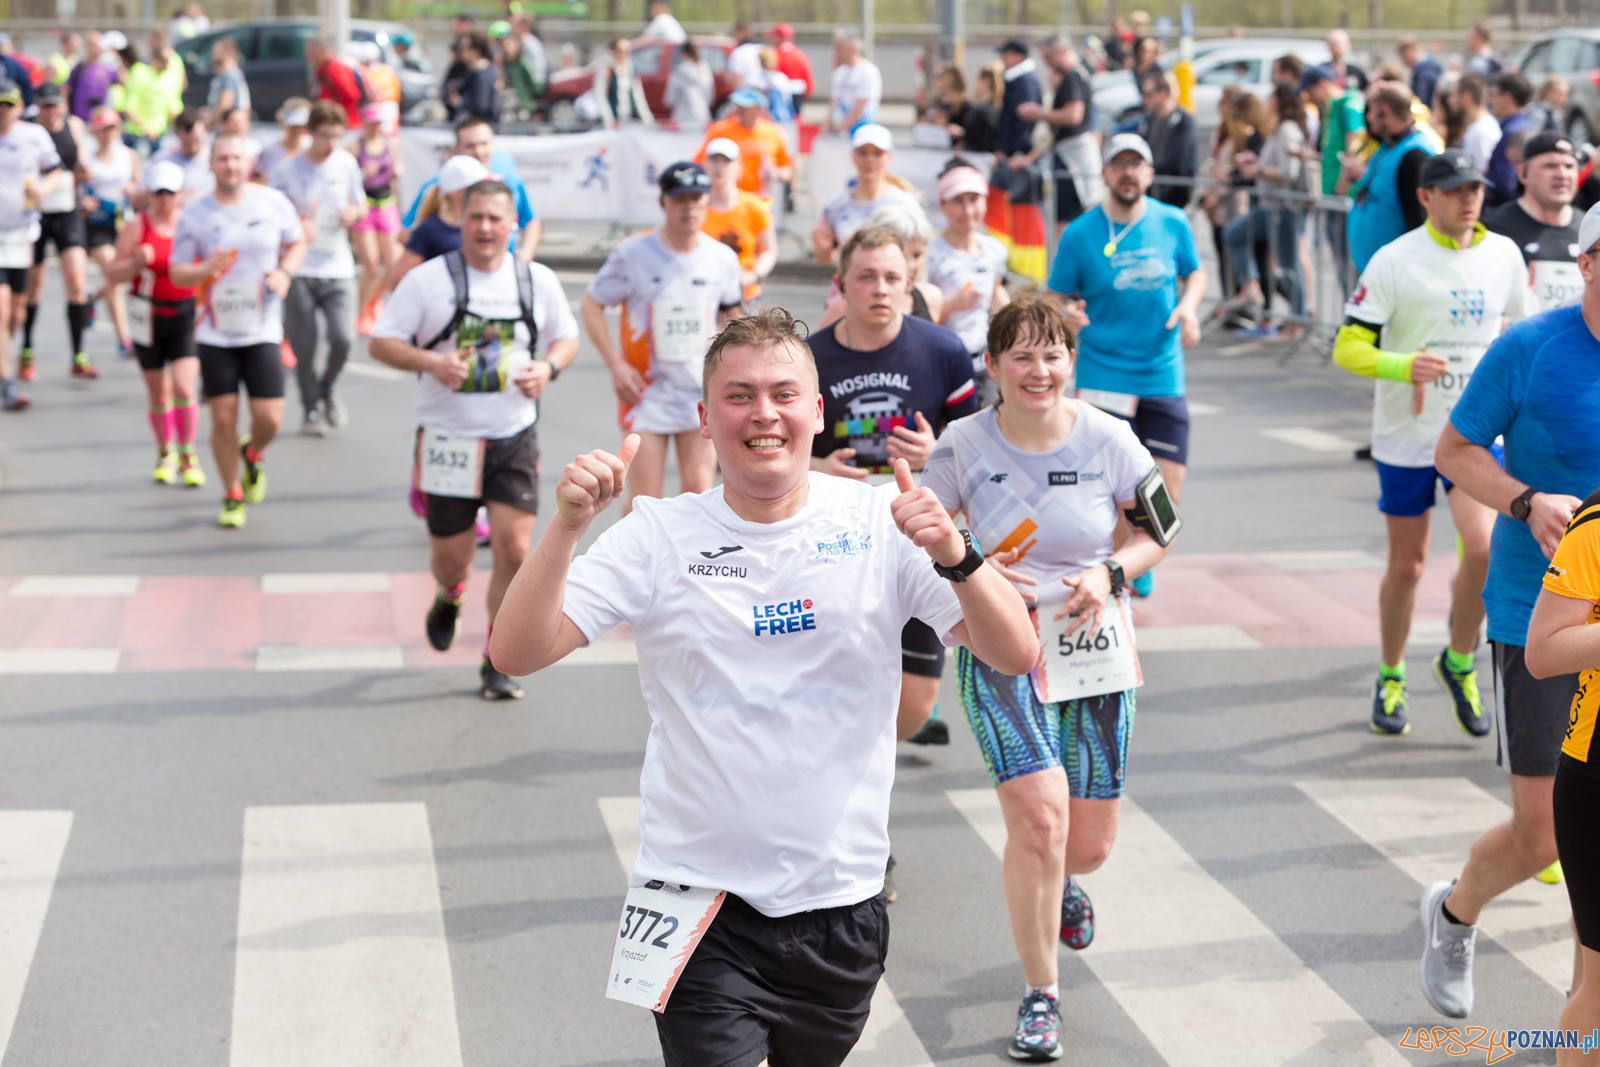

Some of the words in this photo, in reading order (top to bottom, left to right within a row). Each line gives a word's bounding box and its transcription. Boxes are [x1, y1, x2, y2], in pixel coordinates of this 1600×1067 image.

[829, 372, 912, 399] NOSIGNAL
[426, 447, 469, 470] 3632
[817, 536, 857, 553] Postaw
[825, 547, 841, 557] na
[842, 541, 868, 554] ruch
[688, 563, 748, 579] KRZYCHU
[752, 599, 802, 619] LECH
[754, 612, 817, 637] FREE
[1058, 624, 1119, 657] 5461
[620, 904, 679, 950] 3772
[620, 947, 649, 962] Krzysztof
